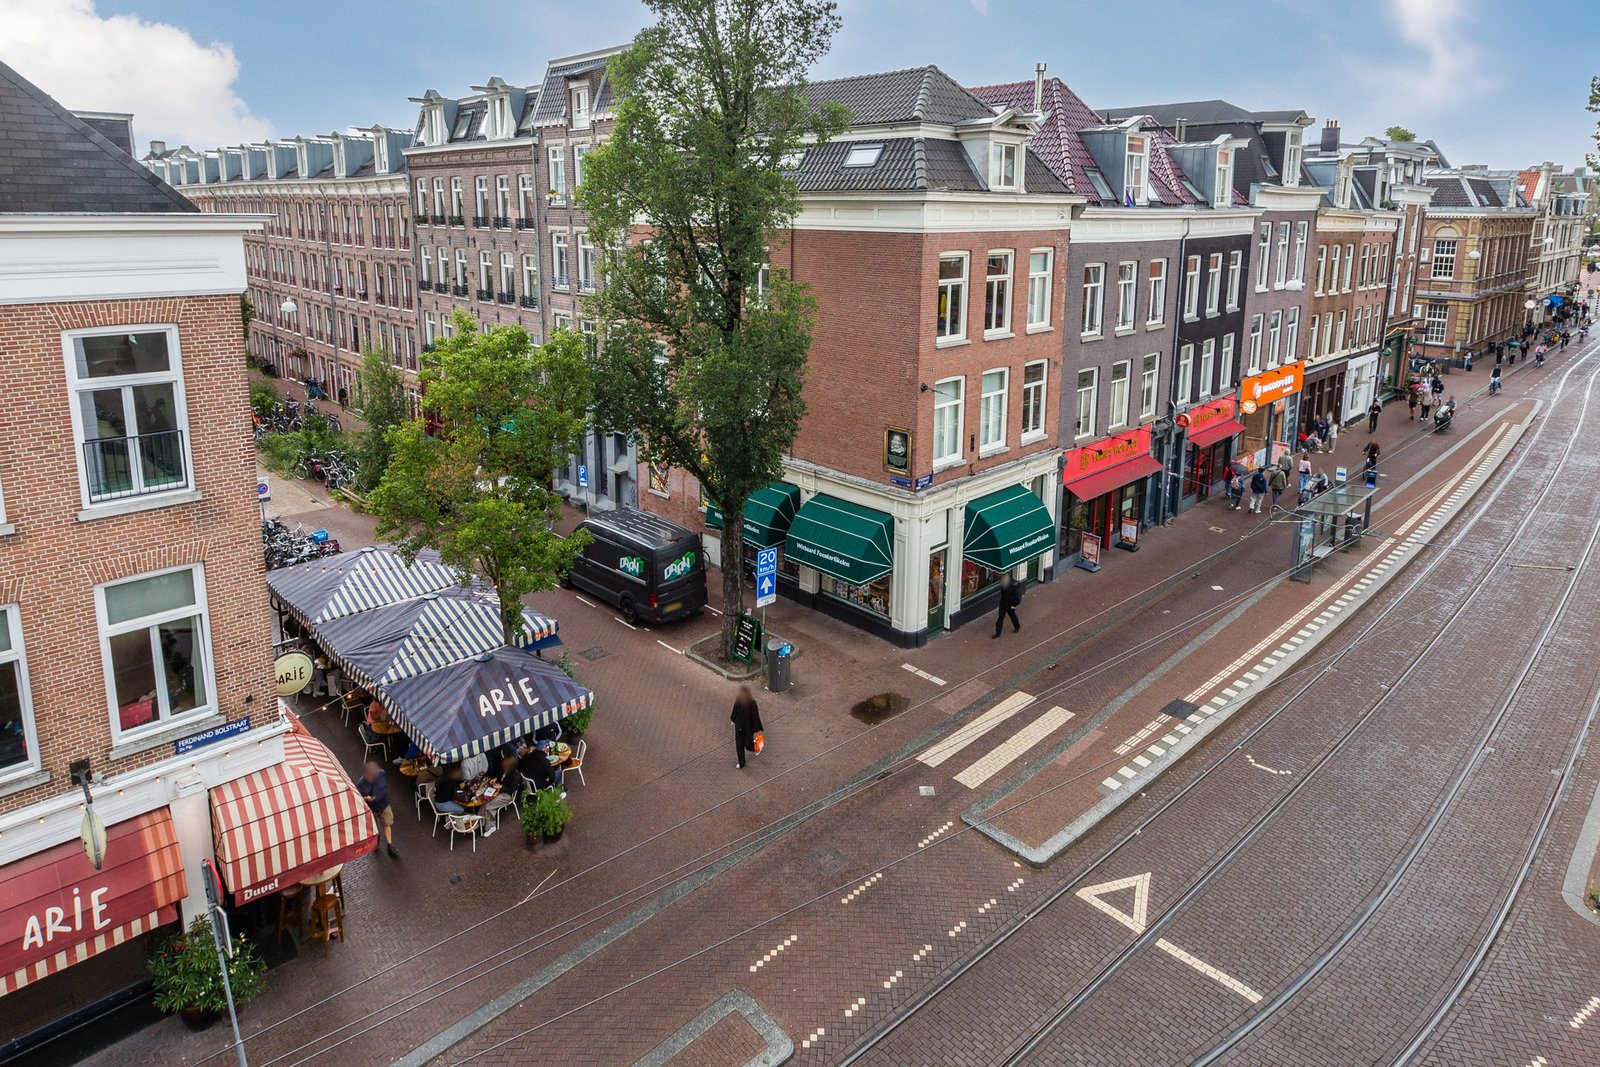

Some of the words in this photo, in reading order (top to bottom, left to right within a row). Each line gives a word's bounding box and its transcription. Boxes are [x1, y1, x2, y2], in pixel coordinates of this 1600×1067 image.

[580, 467, 585, 476] P
[760, 551, 775, 565] 20
[760, 564, 775, 572] km/h
[178, 731, 214, 747] FERDINAND
[214, 719, 248, 735] BOLSTRAAT
[243, 878, 280, 901] Duvel
